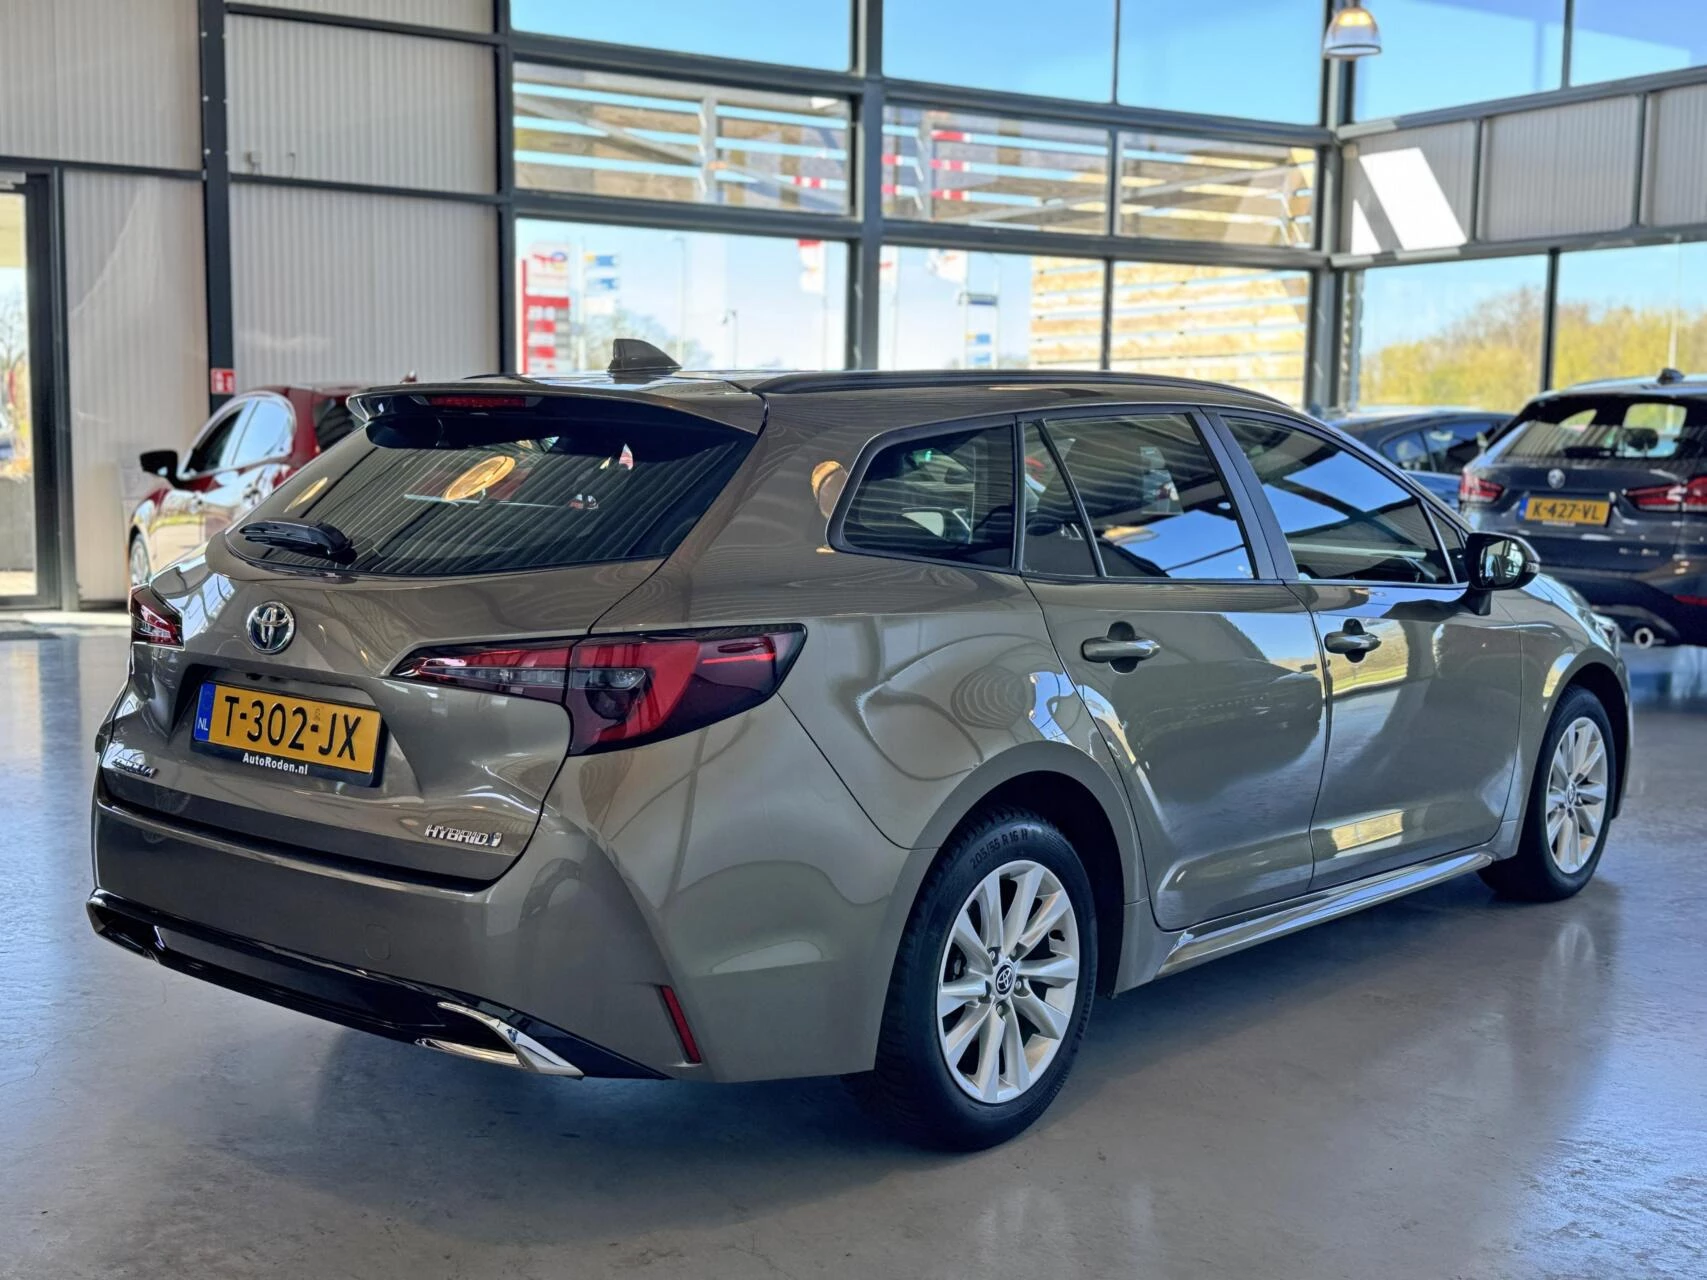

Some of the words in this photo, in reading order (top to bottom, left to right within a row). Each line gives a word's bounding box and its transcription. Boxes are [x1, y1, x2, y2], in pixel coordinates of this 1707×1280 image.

[1532, 502, 1600, 521] K-427-VL
[198, 718, 208, 732] NL
[224, 695, 361, 761] T-302-JX
[242, 752, 308, 775] AutoRoden.nl
[424, 824, 488, 845] HYBRID
